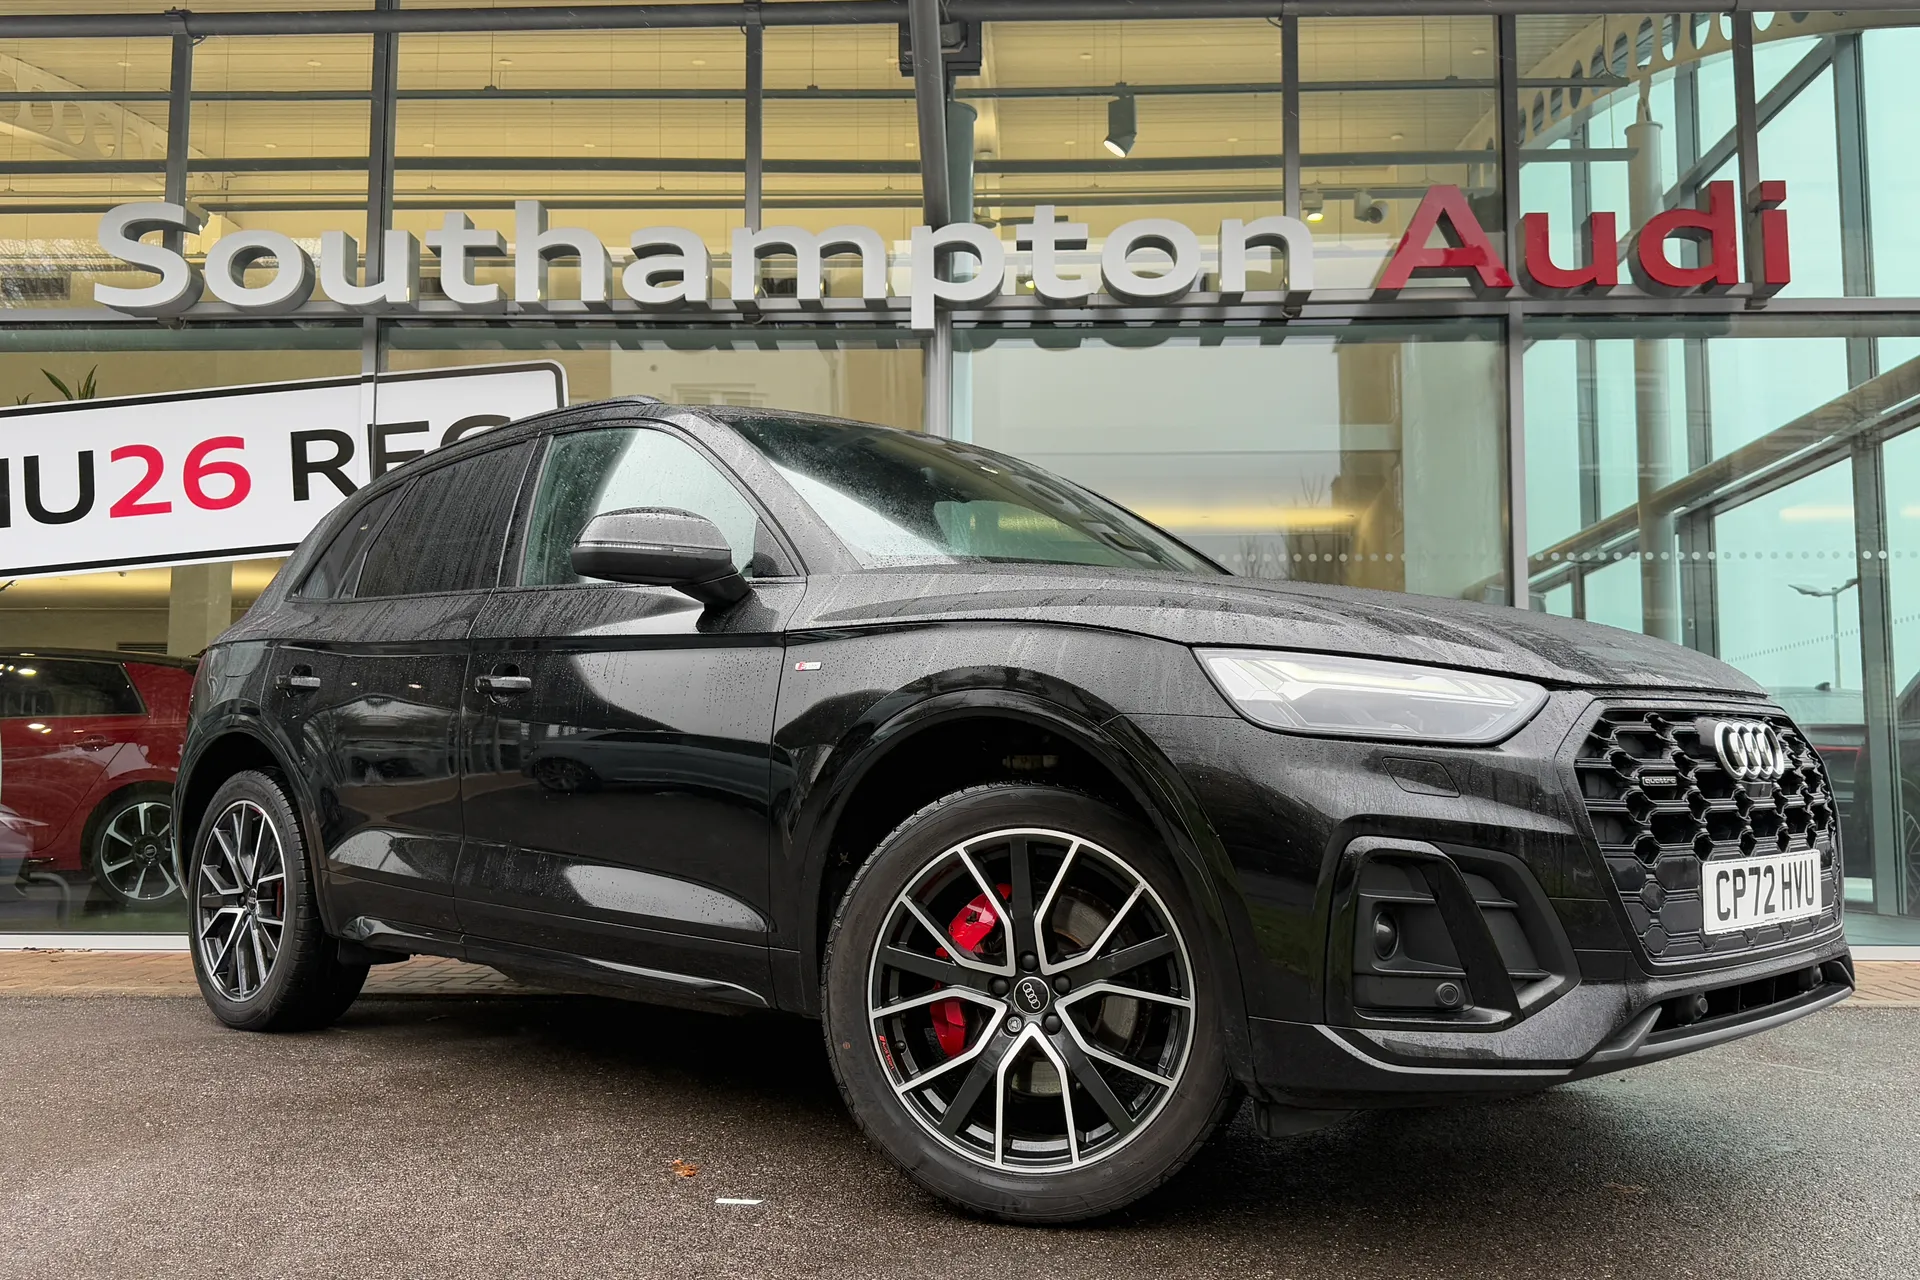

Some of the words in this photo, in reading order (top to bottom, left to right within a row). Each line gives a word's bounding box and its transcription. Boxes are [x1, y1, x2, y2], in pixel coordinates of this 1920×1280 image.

[94, 200, 1314, 330] Southampton
[1375, 180, 1790, 296] Audi
[1716, 864, 1775, 921] CP72
[1781, 859, 1814, 911] HVU
